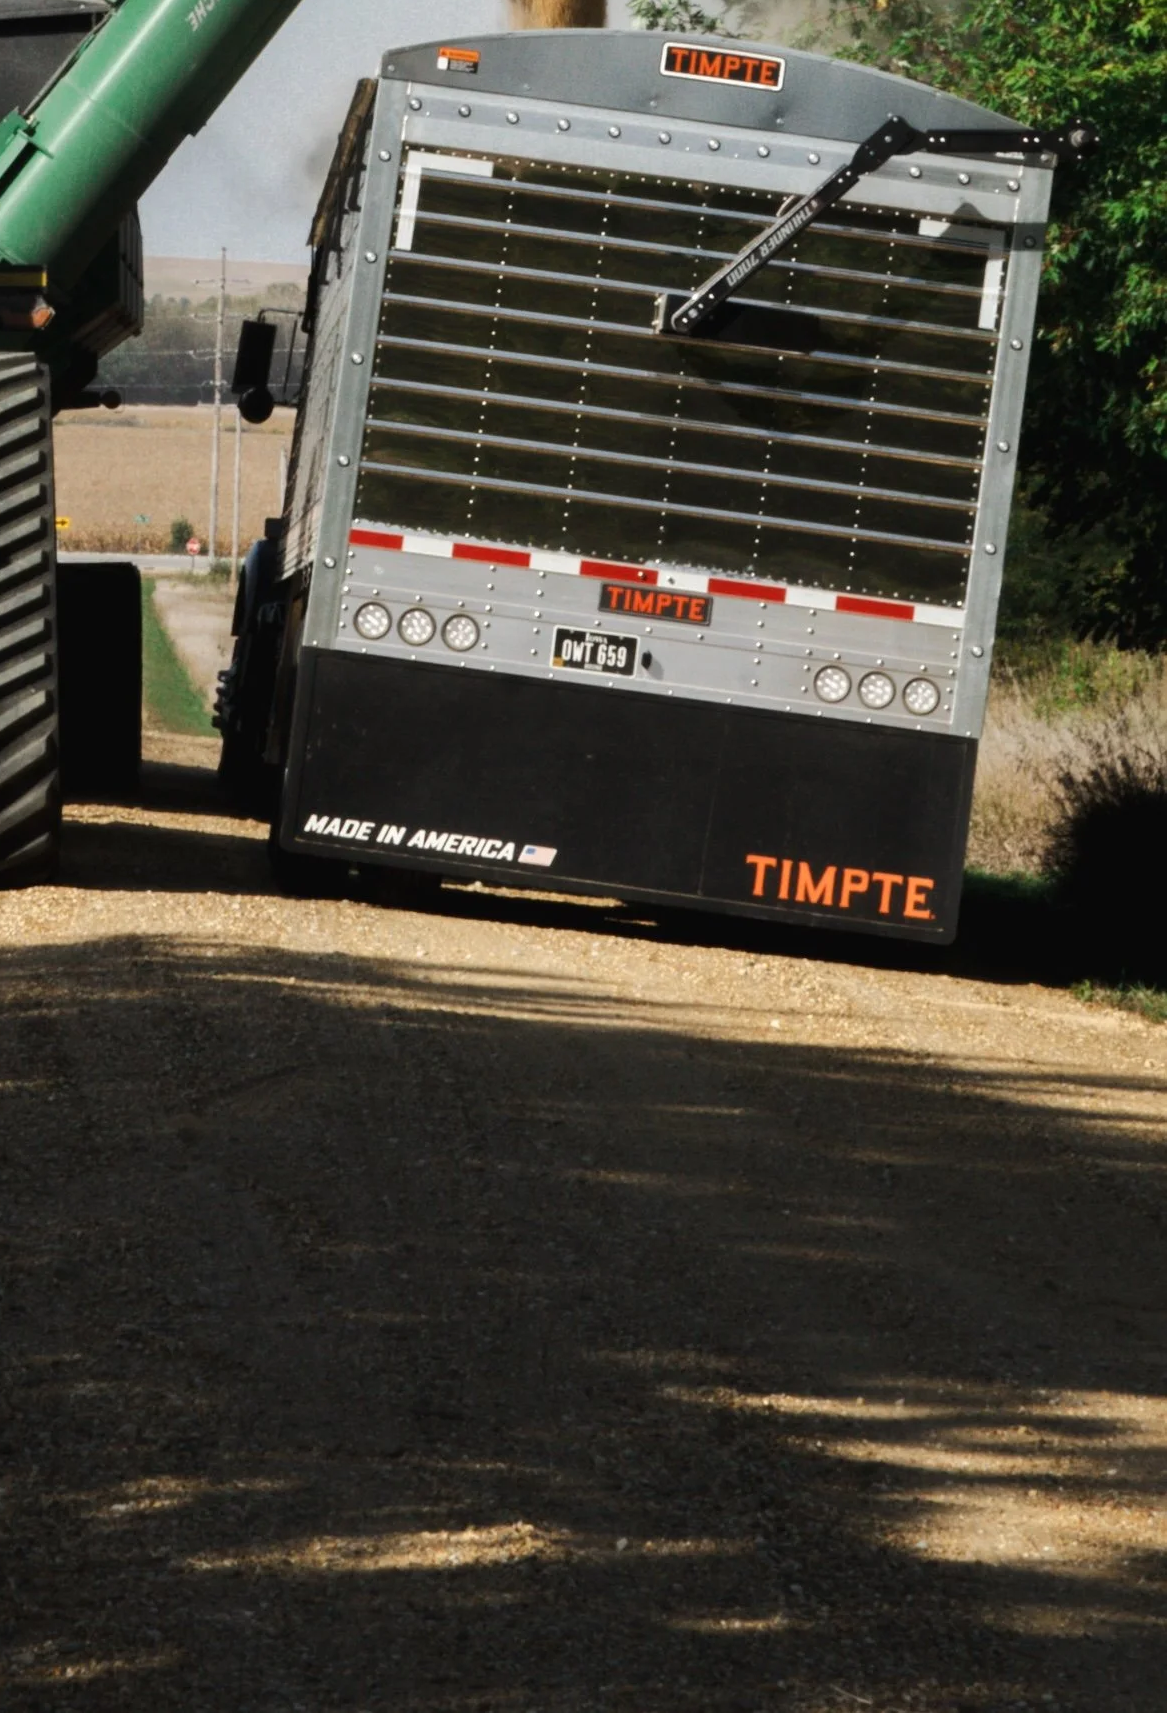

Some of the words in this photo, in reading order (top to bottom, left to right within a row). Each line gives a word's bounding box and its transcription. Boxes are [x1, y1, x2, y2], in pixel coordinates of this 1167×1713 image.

[671, 48, 777, 85] TIMPTE
[760, 204, 814, 260] THUNDER
[725, 254, 760, 287] 7000
[607, 585, 706, 622] TIMPTE
[596, 643, 628, 668] 659
[303, 814, 375, 841] MADE
[376, 824, 406, 846] IN
[407, 830, 516, 861] AMERICA
[745, 854, 935, 920] TIMPTE
